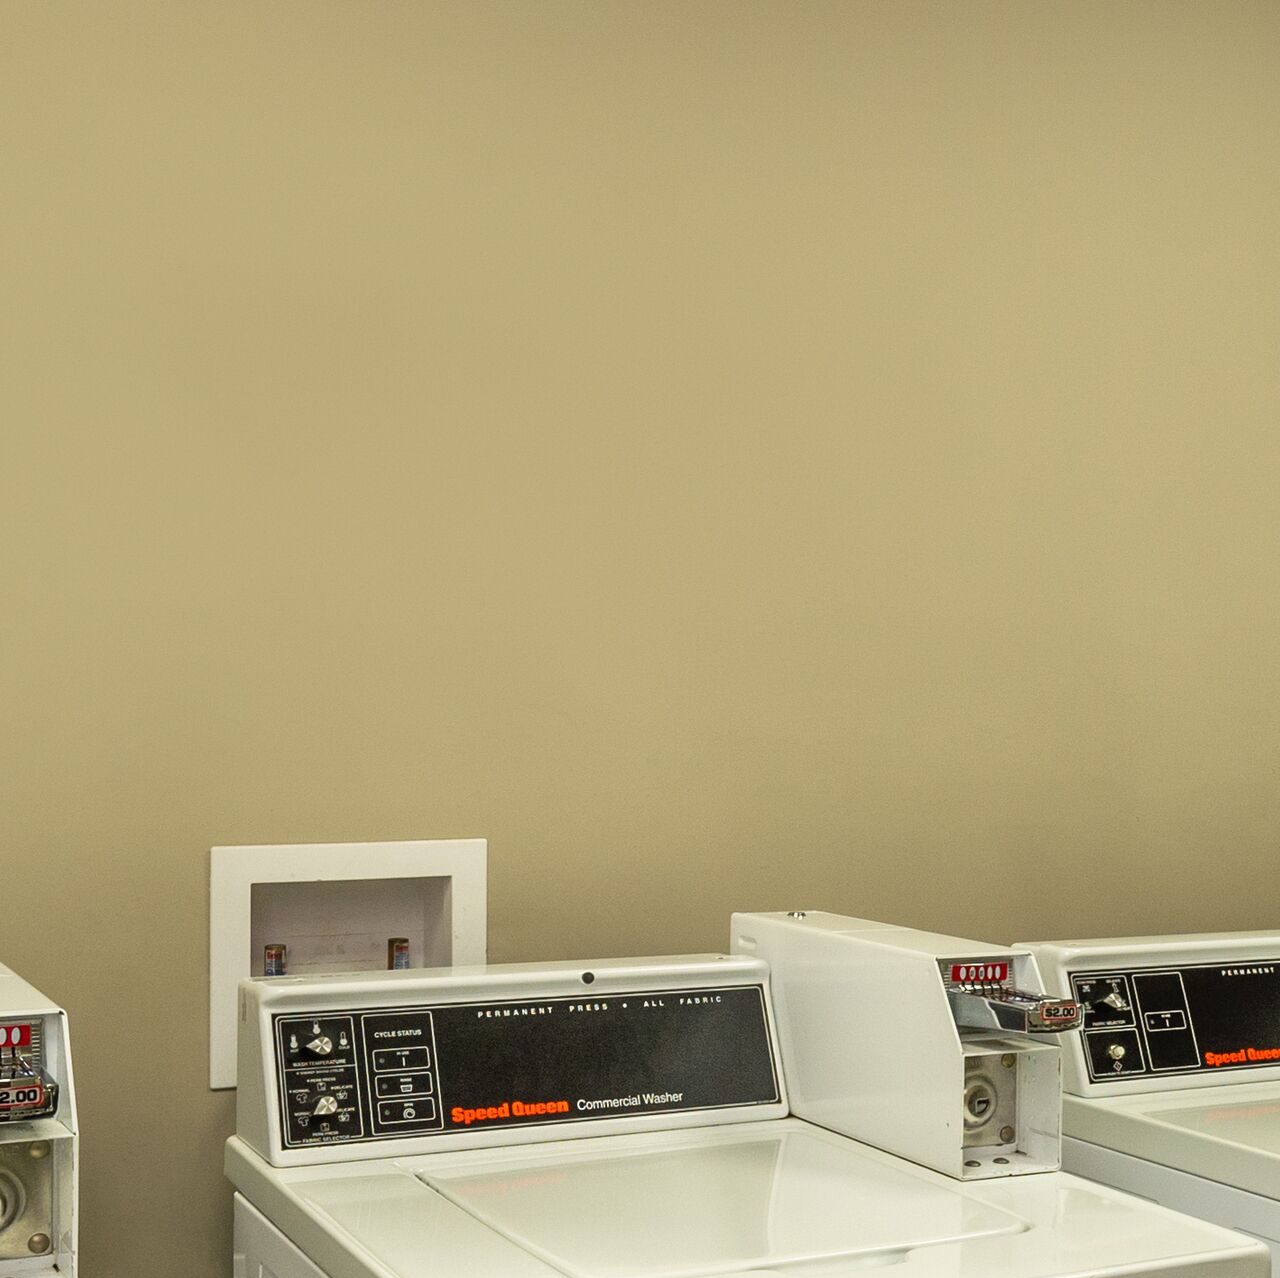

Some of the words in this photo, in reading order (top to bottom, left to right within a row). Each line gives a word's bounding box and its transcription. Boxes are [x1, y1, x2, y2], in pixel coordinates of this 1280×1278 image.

[1221, 967, 1275, 976] PERMANENT
[477, 1006, 553, 1019] PERMANENT
[569, 1003, 608, 1013] PRESS
[643, 1000, 665, 1008] ALL
[679, 996, 722, 1005] FABRIC
[1045, 1007, 1075, 1018] $2.00
[374, 1031, 396, 1039] CYCLE
[397, 1029, 422, 1037] STATUS
[1205, 1049, 1247, 1067] Speed
[451, 1102, 510, 1125] Speed
[511, 1099, 570, 1117] Queen
[576, 1094, 641, 1111] Commercial
[642, 1092, 683, 1104] Washer
